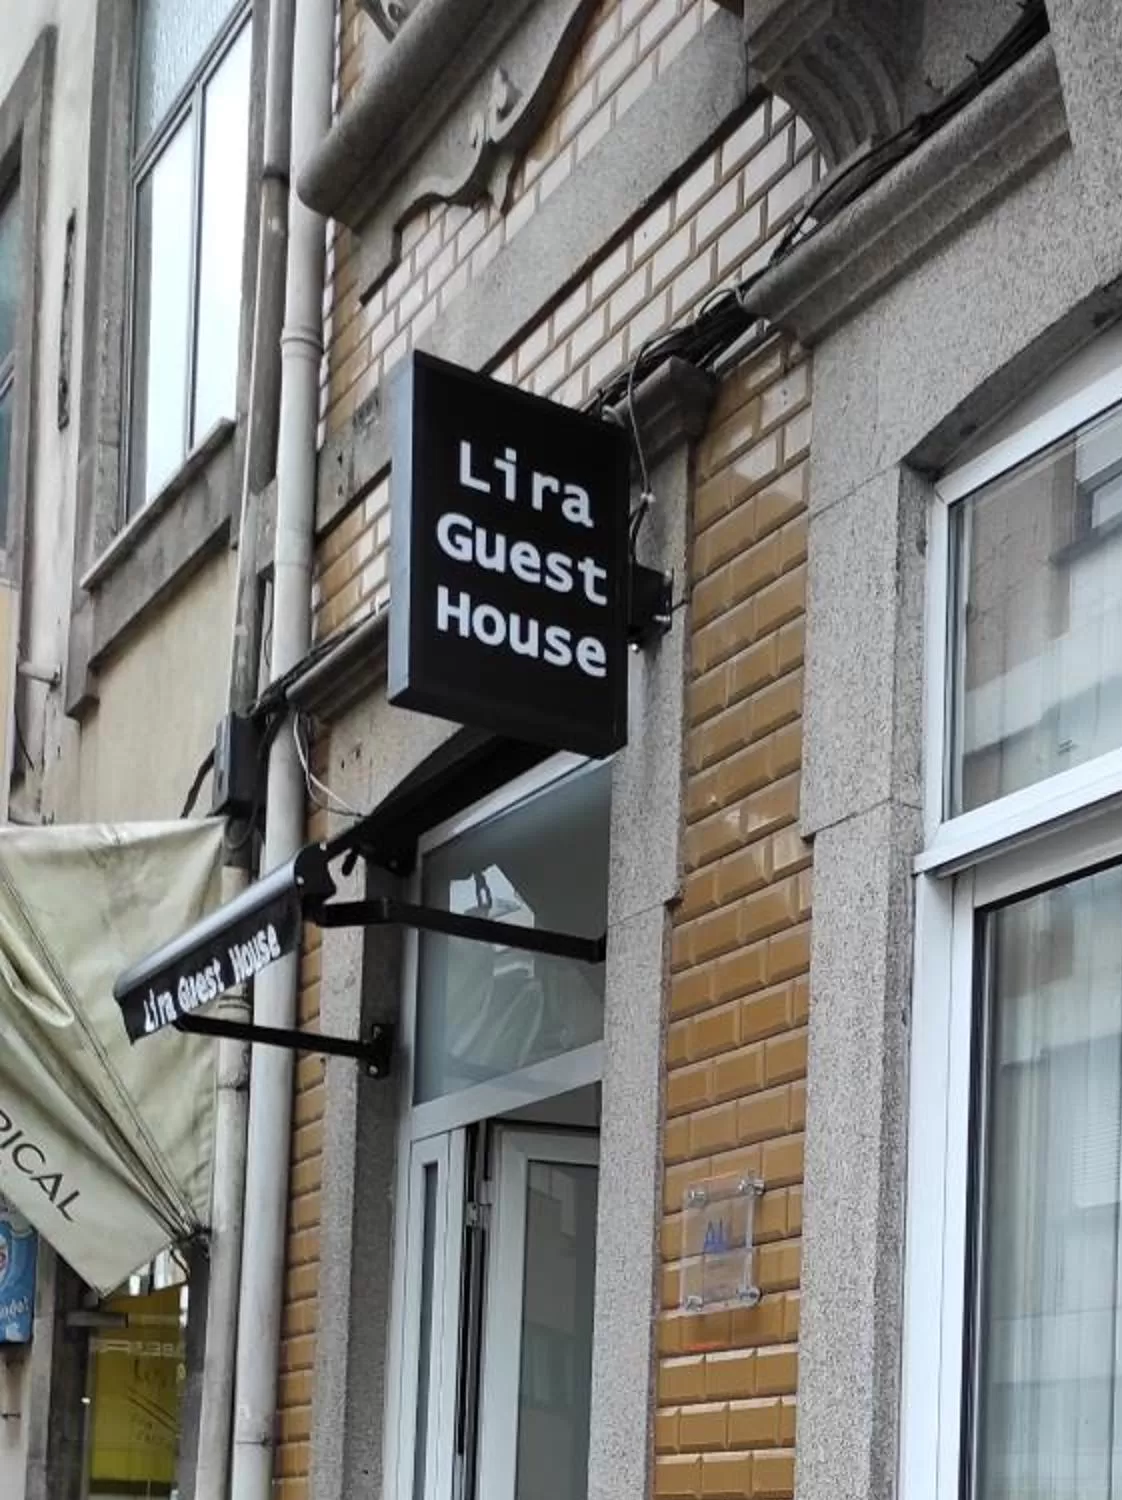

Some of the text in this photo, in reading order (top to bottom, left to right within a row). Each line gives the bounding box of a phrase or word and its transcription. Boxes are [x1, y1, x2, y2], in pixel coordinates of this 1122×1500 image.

[459, 439, 594, 528] Lira
[436, 512, 607, 606] Guest
[437, 584, 607, 678] House
[143, 923, 281, 1033] Lira Guest House
